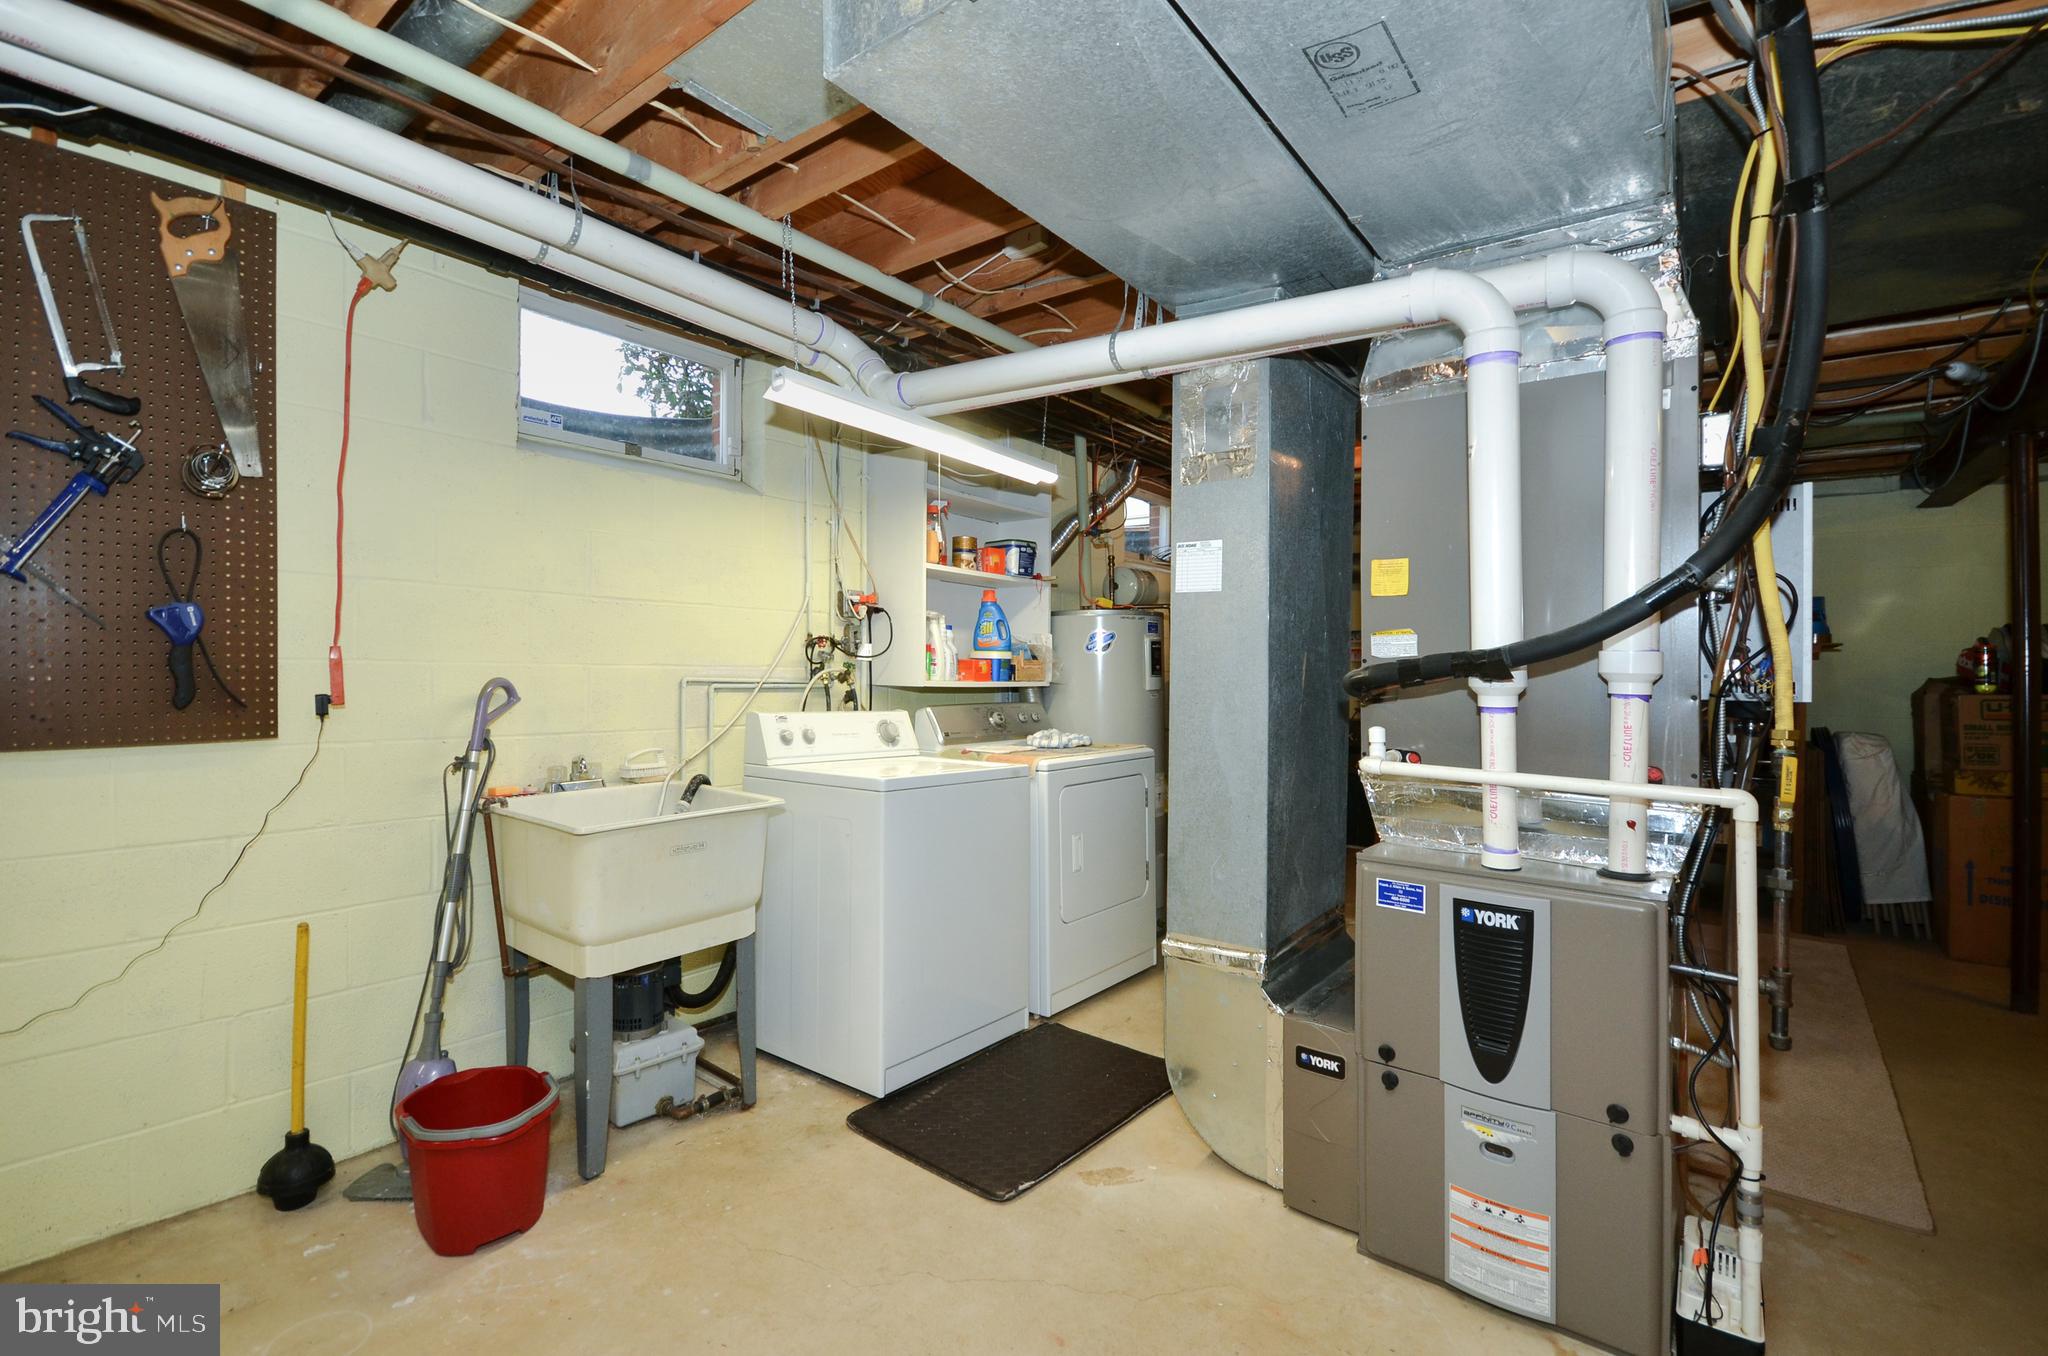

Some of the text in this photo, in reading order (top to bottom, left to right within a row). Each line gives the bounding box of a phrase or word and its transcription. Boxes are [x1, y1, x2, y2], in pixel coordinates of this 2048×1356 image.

[1319, 47, 1354, 63] USS
[980, 620, 994, 635] all
[1474, 909, 1519, 930] YORK
[1310, 1055, 1339, 1072] YORK
